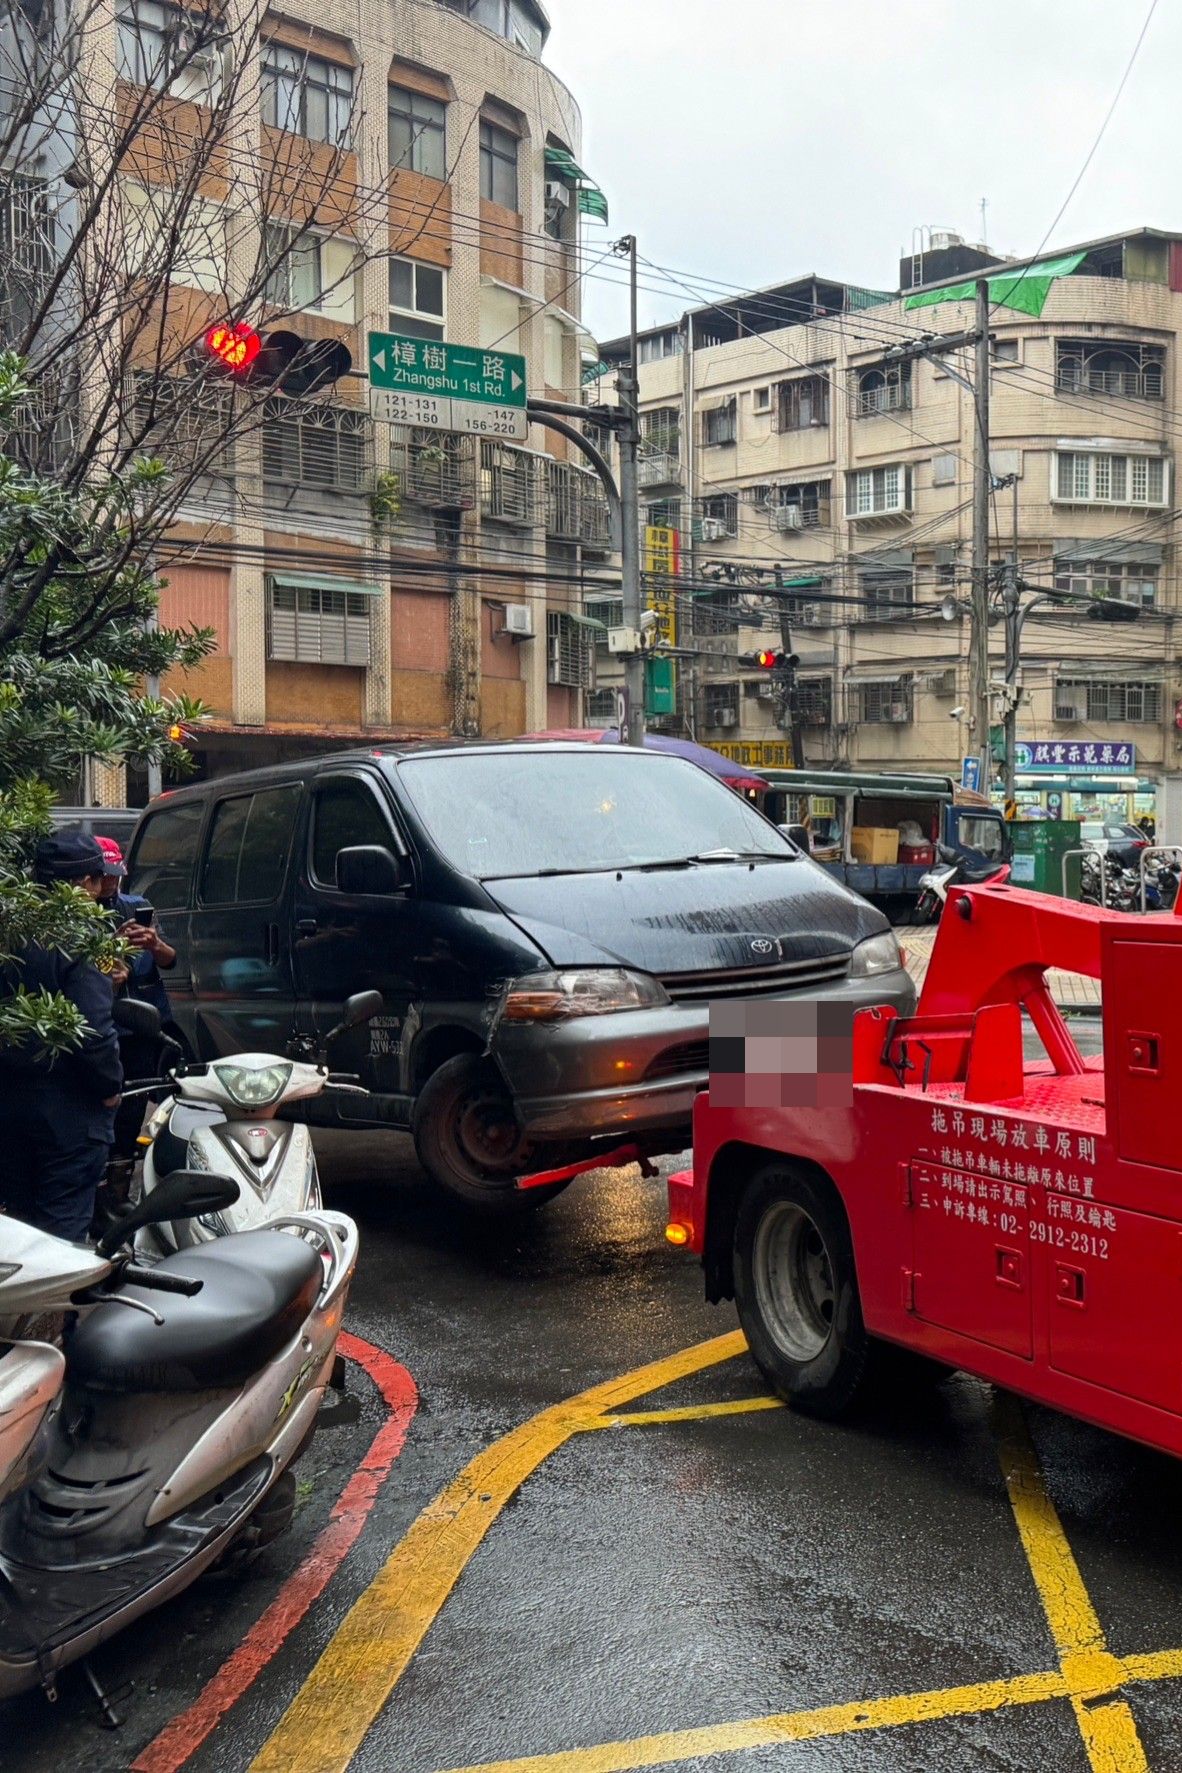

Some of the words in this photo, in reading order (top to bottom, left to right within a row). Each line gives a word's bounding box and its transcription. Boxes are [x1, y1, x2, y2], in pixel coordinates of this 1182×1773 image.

[391, 340, 506, 382] 樟樹一路
[393, 367, 458, 390] Zhangshu
[463, 379, 481, 394] 1st
[484, 381, 506, 397] Rd.
[384, 394, 437, 411] 121-131
[385, 408, 438, 424] 122-150
[465, 419, 516, 435] 156-220
[931, 1107, 1096, 1165] 拖吊現場放車原則
